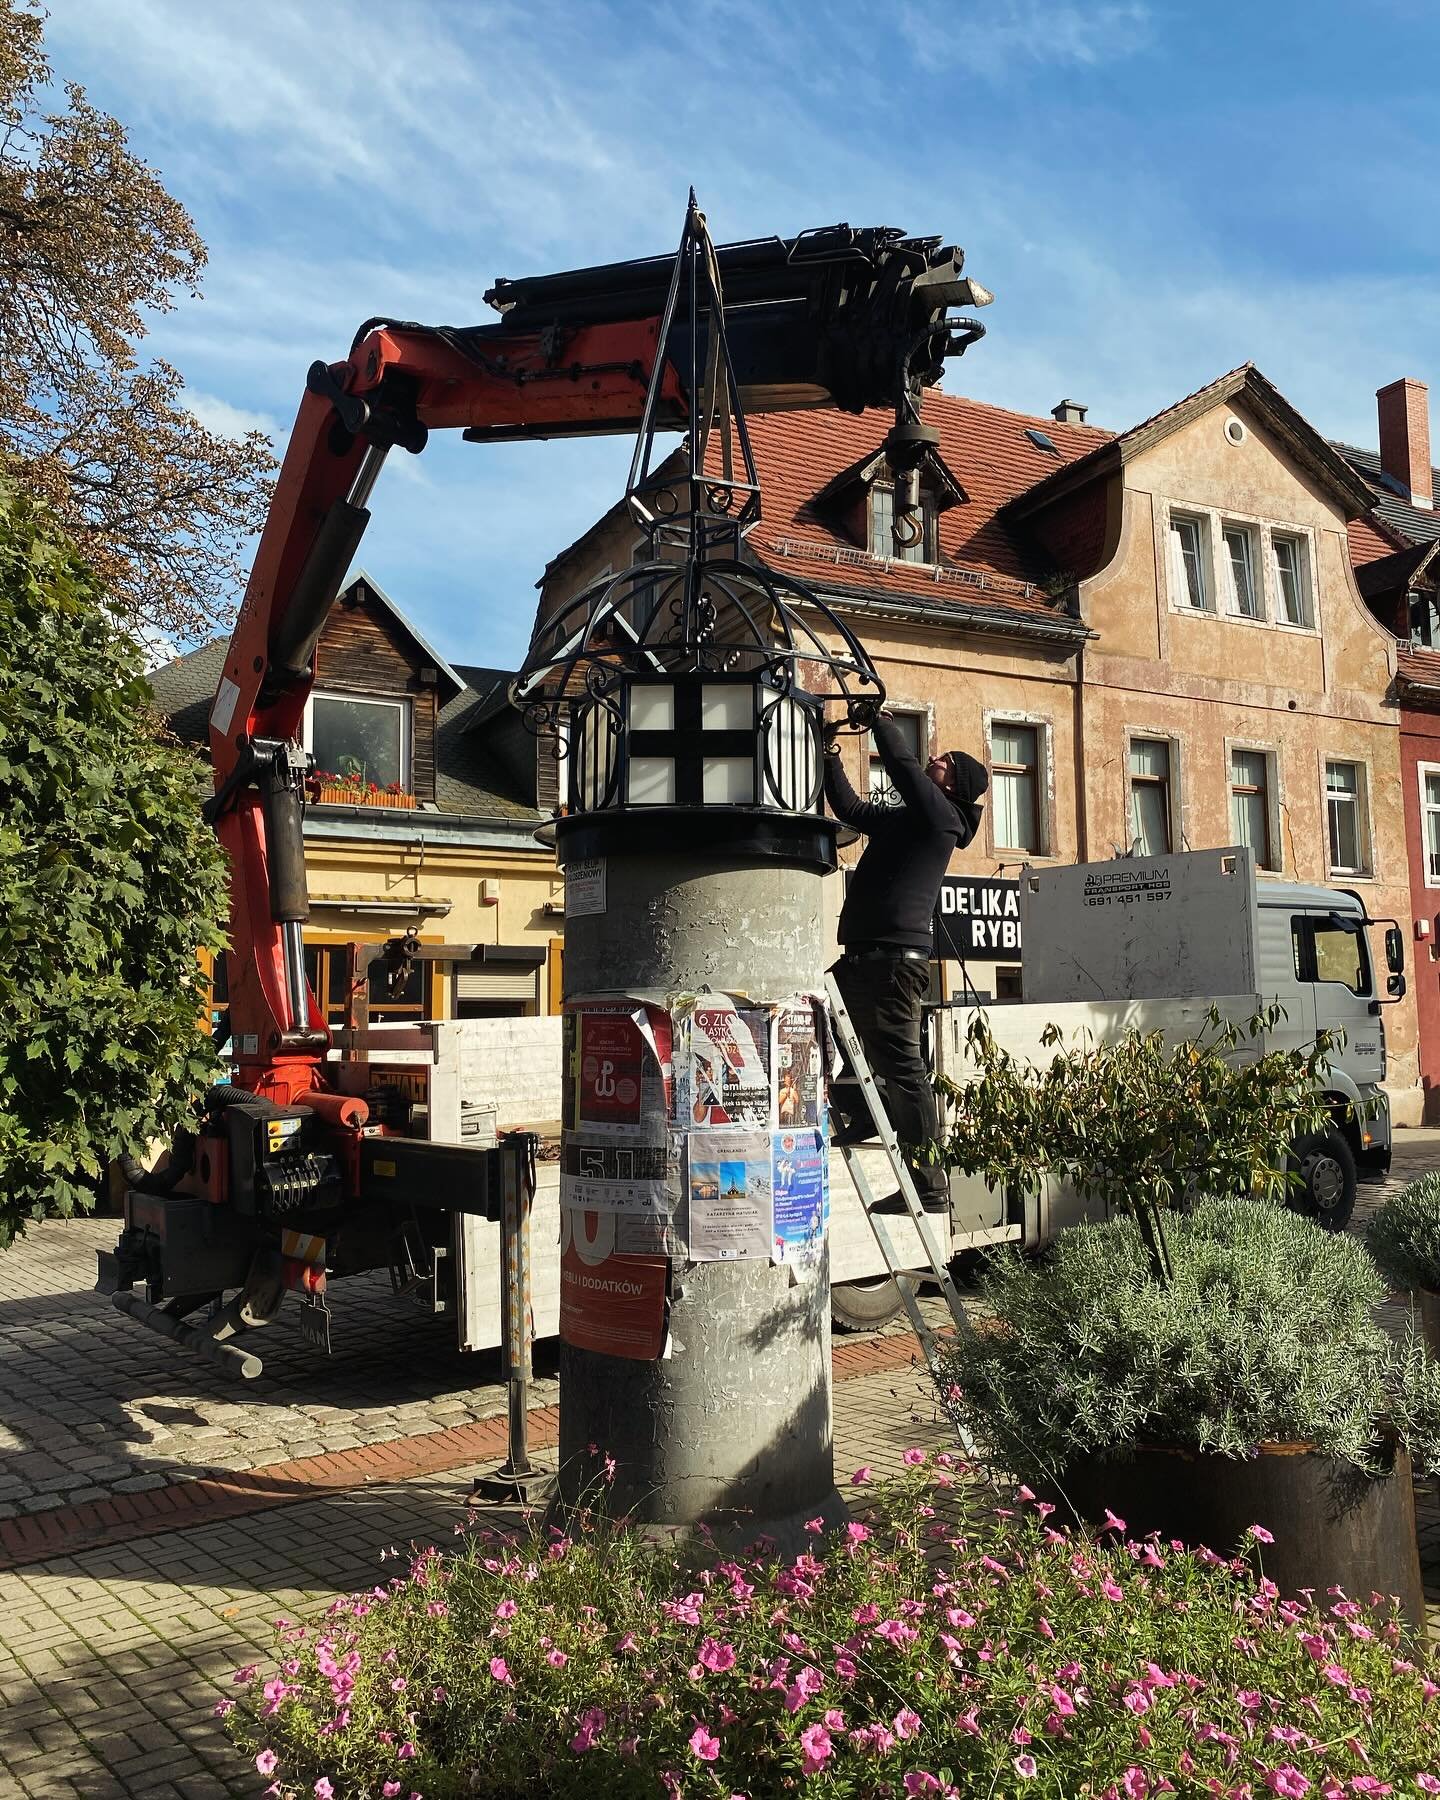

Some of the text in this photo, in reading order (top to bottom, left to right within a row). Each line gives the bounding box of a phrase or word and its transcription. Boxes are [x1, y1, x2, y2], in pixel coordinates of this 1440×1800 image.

[1103, 868, 1169, 885] PREMIUM
[1085, 884, 1144, 896] TRANSPORT
[1088, 891, 1172, 906] 691 451 597
[699, 1013, 711, 1027] 6.
[582, 1276, 643, 1296] DODATKÓW
